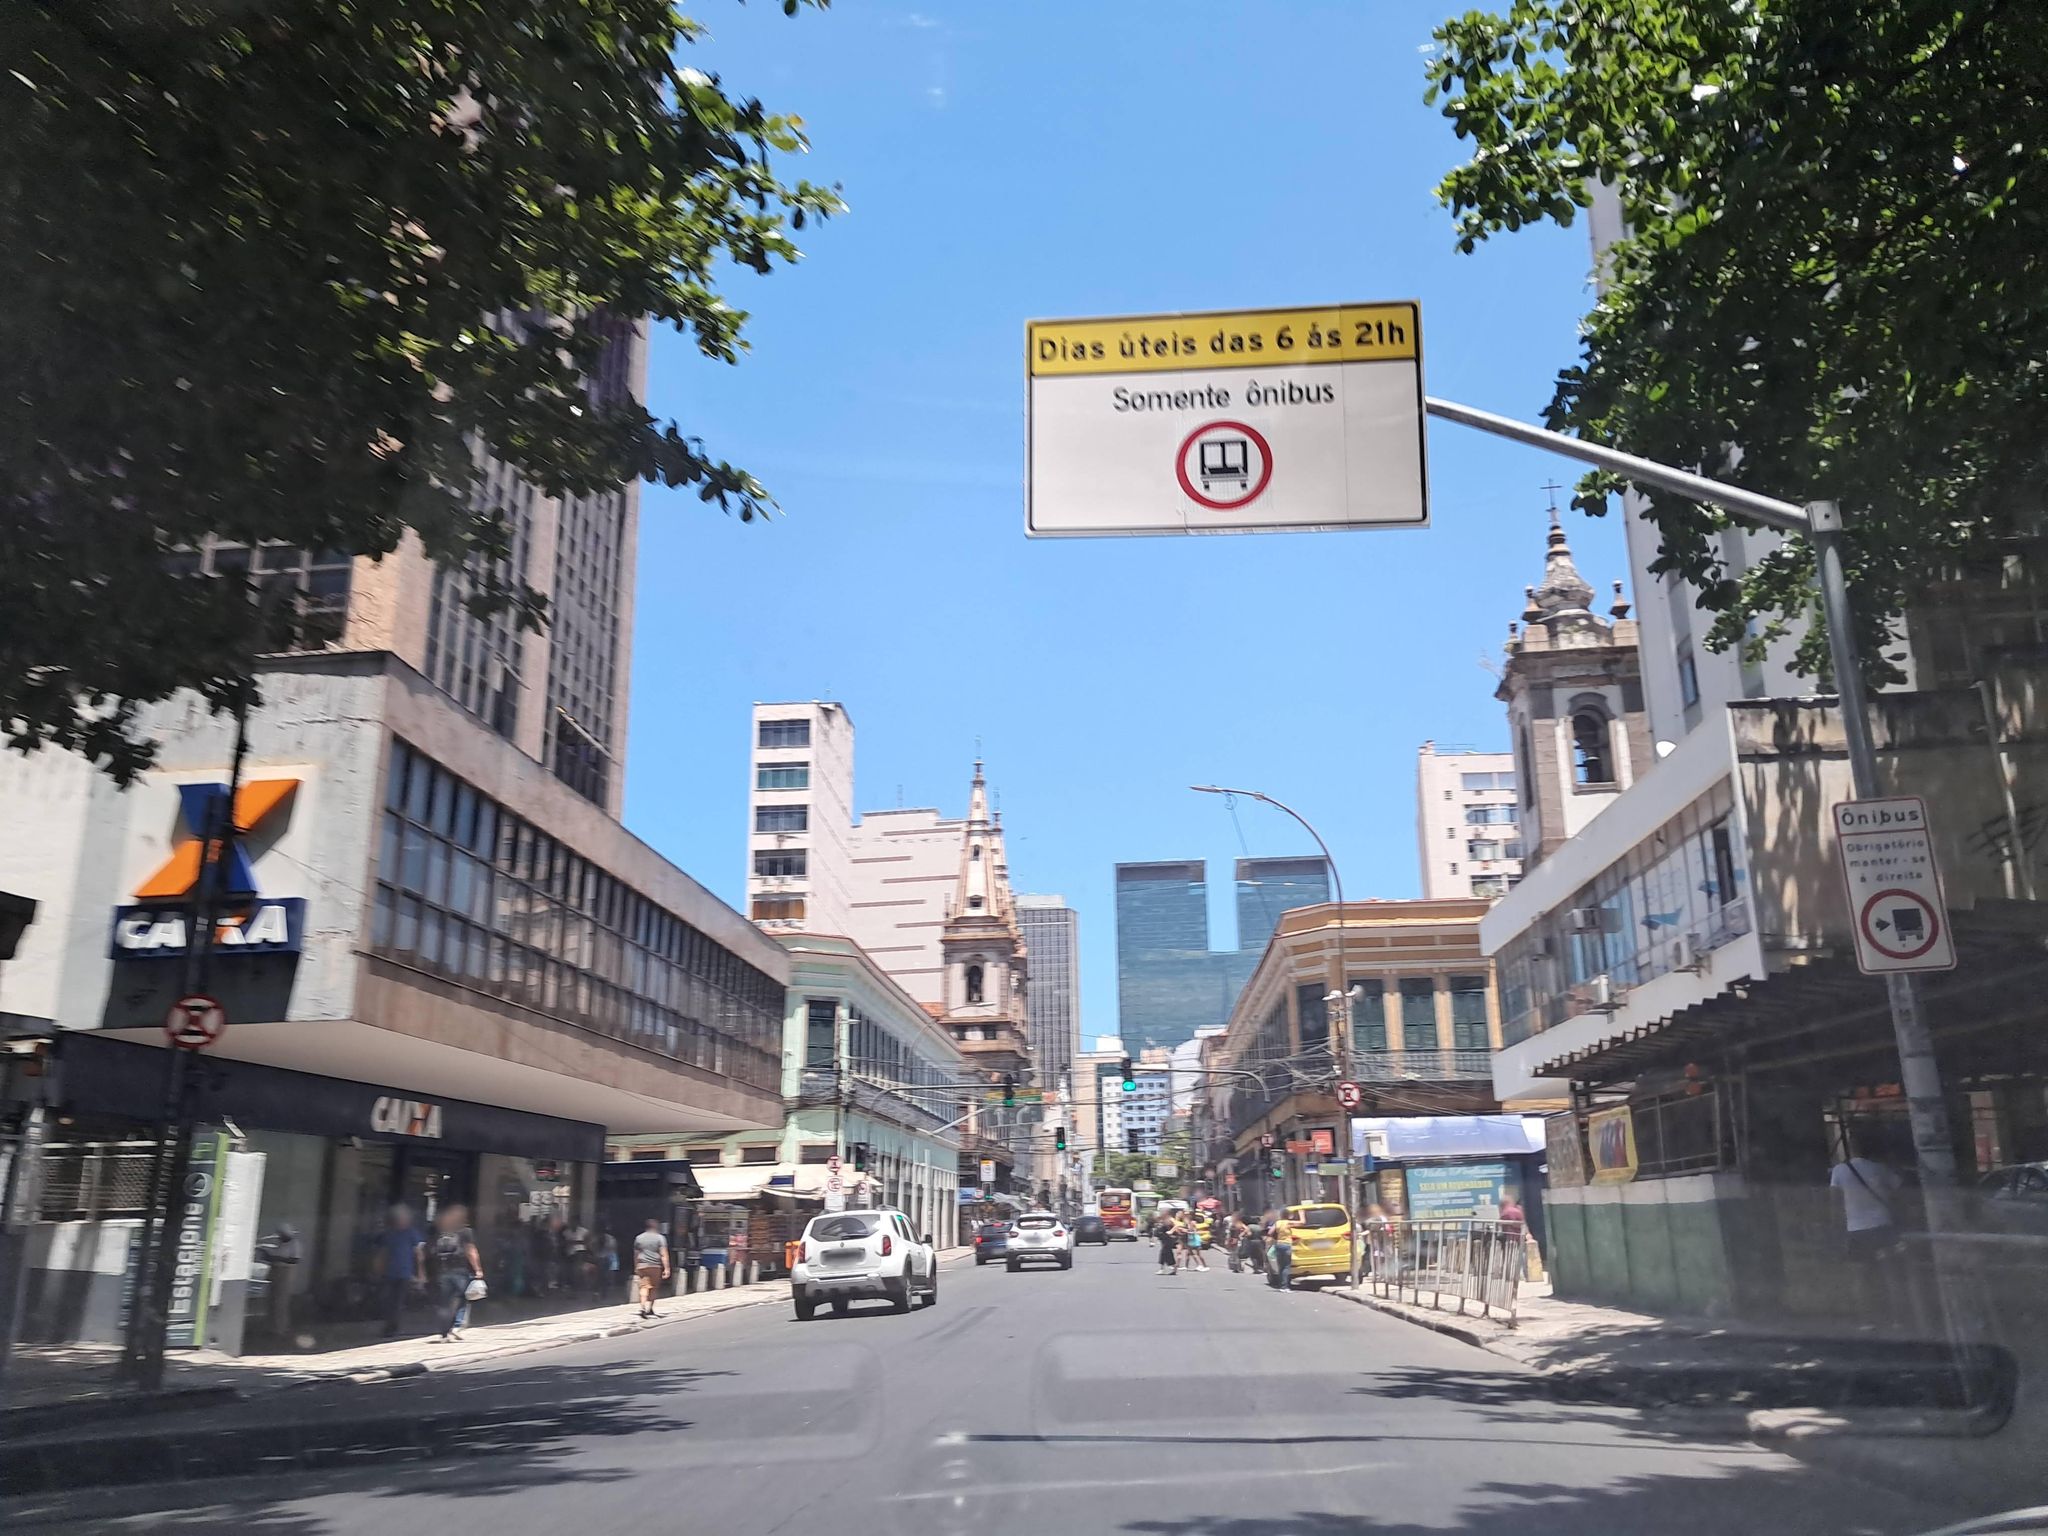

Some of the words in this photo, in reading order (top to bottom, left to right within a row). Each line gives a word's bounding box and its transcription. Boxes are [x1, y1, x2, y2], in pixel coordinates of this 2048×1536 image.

[1039, 336, 1105, 362] Dias
[1209, 329, 1264, 354] das
[1276, 324, 1295, 350] 6
[1355, 320, 1406, 347] 21h
[1113, 382, 1231, 412] Somente
[1246, 378, 1335, 406] ônibus
[1841, 807, 1919, 826] Ônibus
[1846, 840, 1925, 853] Obrigatório
[1876, 871, 1923, 882] direita
[115, 904, 289, 950] CAXA
[370, 1096, 442, 1138] CAIXA
